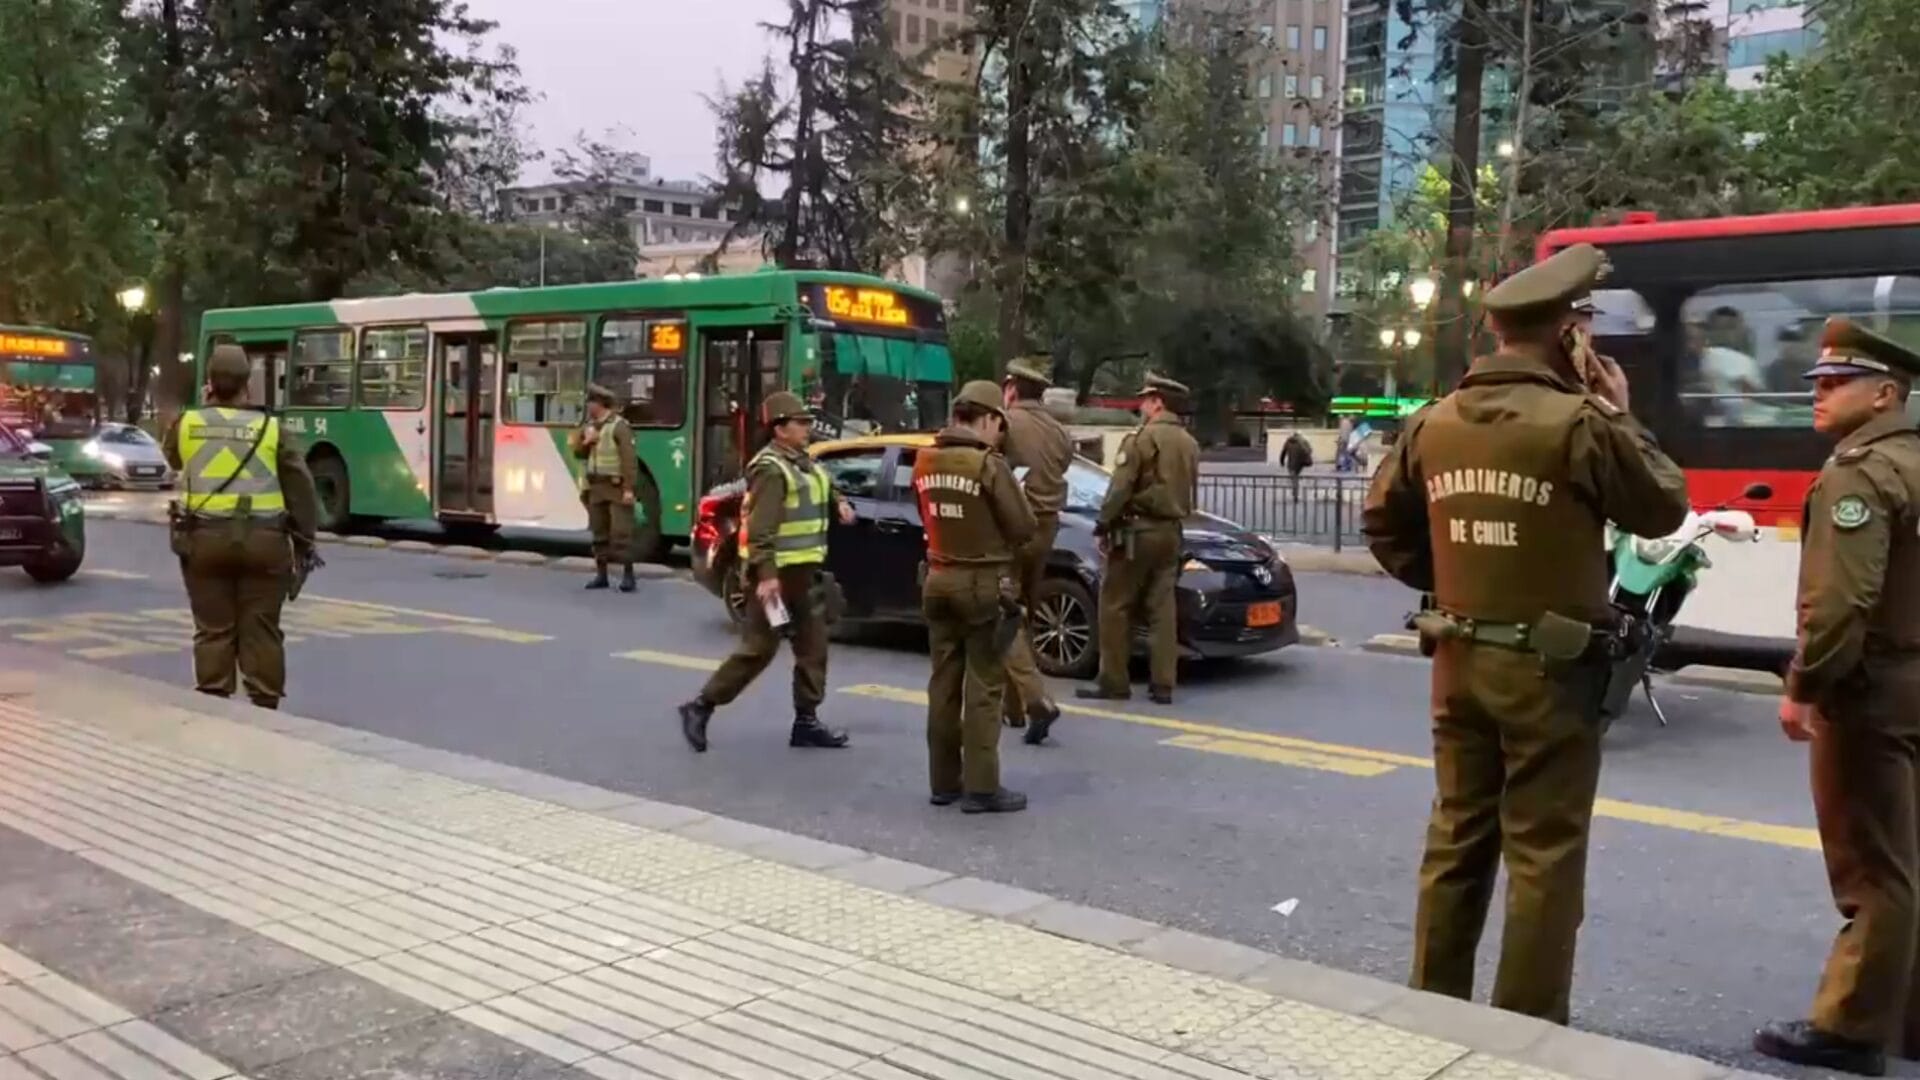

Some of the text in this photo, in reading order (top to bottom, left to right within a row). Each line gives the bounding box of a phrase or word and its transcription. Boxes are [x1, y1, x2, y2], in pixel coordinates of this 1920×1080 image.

[916, 473, 981, 496] CARABINEROS
[1426, 468, 1553, 506] CARABINEROS
[939, 503, 964, 519] CHILE
[1449, 518, 1519, 546] DE CHILE
